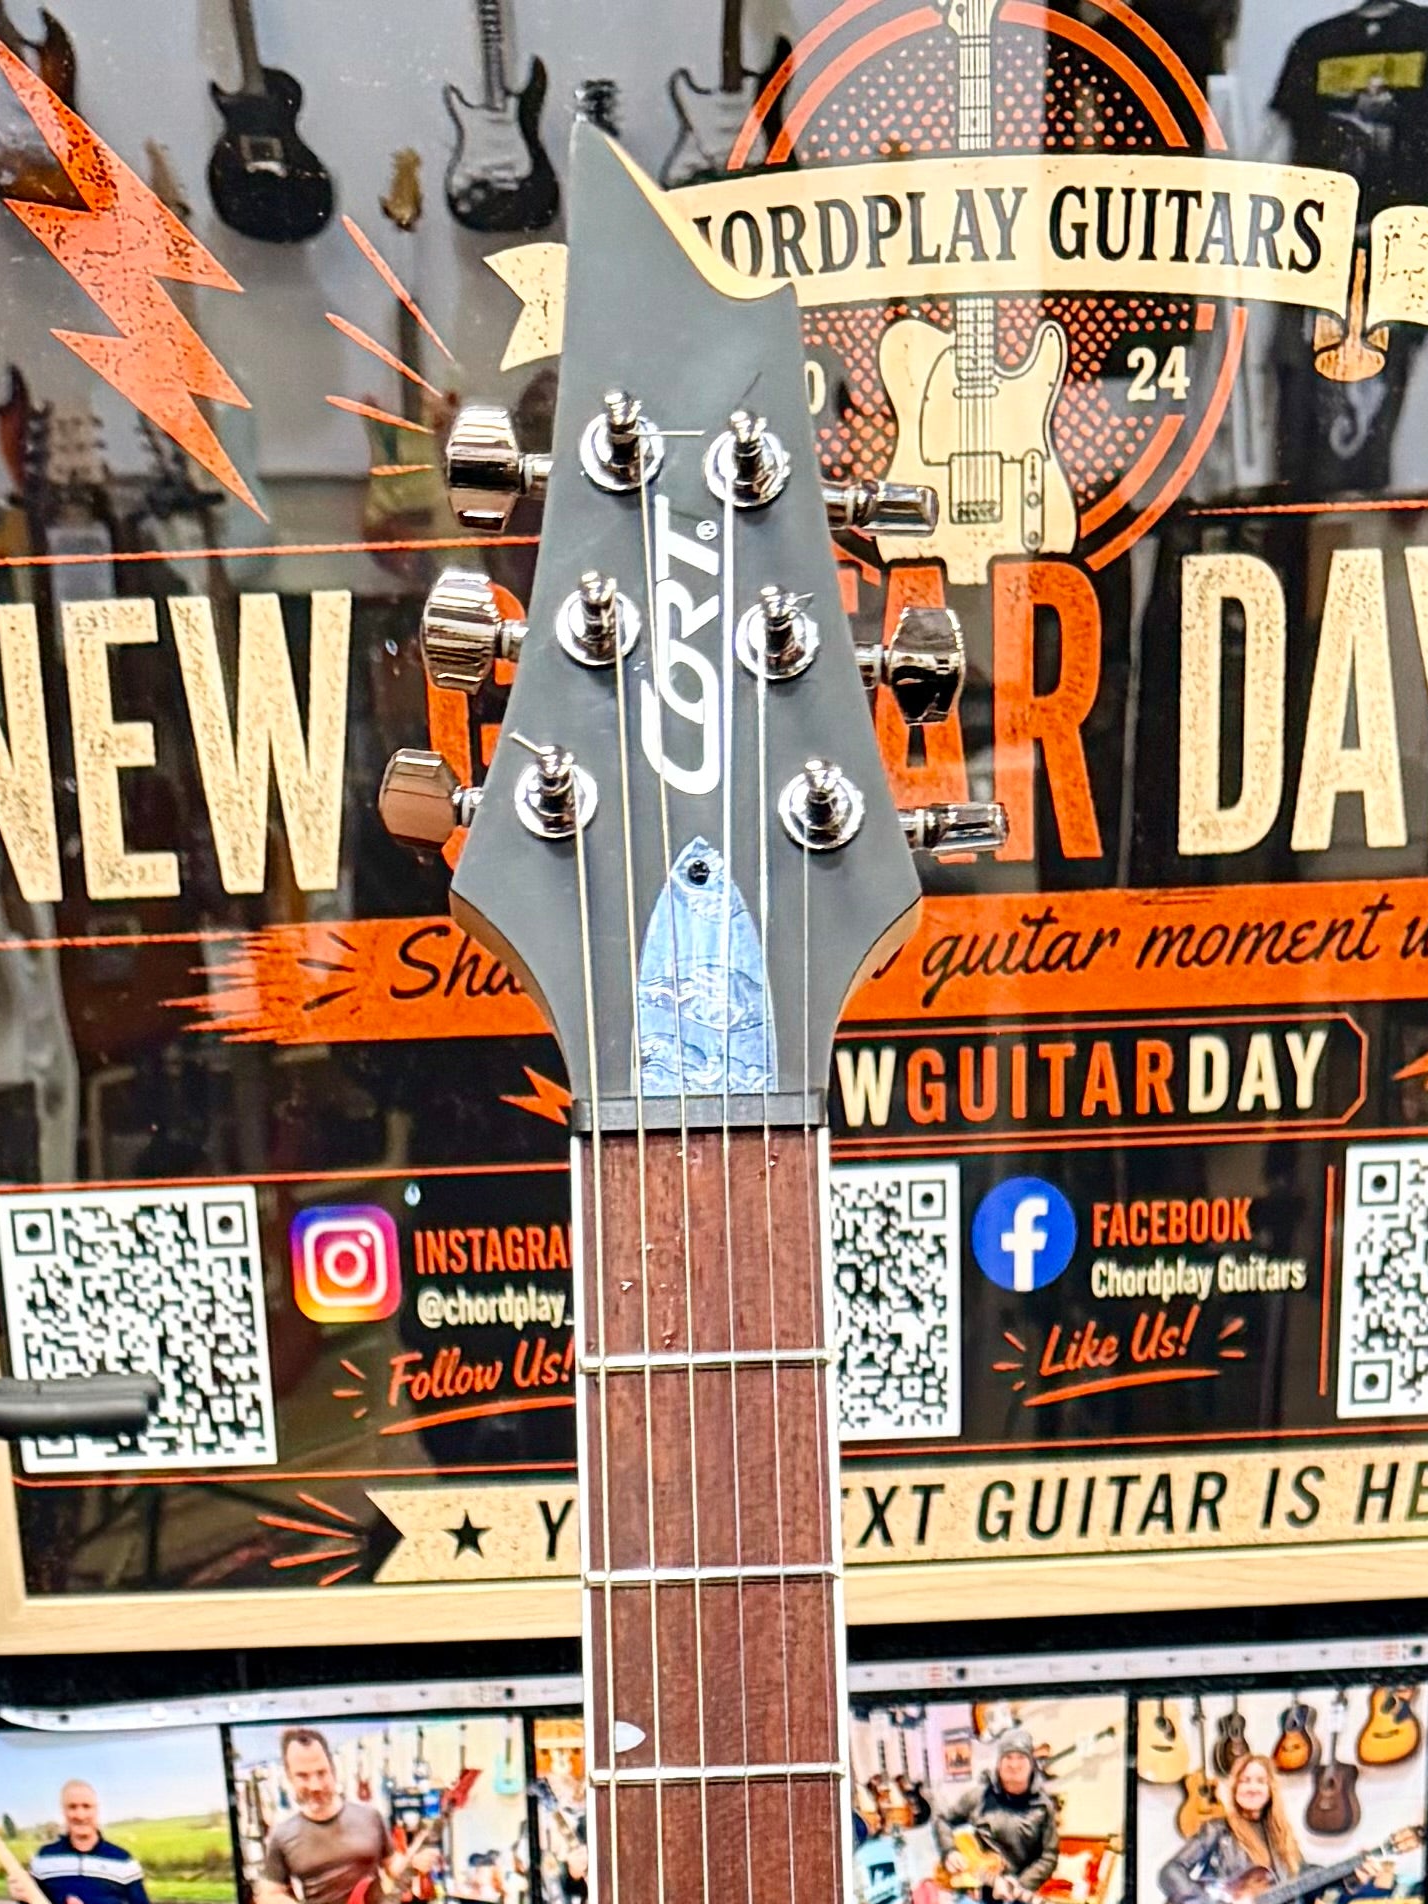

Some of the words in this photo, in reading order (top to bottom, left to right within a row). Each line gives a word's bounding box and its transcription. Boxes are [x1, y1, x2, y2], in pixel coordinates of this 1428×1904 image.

[692, 187, 1027, 279] ORDPLAY
[1050, 185, 1325, 273] GUITARS
[1126, 346, 1189, 401] 24
[922, 905, 1121, 1008] guitar
[1136, 894, 1379, 970] moment
[836, 1031, 1329, 1128] WGUITARDAY
[414, 1224, 572, 1275] INSTAGRA
[1092, 1197, 1253, 1248] FACEBOOK
[417, 1282, 575, 1331] @chordplay_
[1091, 1256, 1214, 1303] Chordplay
[1217, 1255, 1308, 1294] Guitars
[387, 1346, 503, 1407] Follow
[514, 1337, 575, 1387] Us!
[1038, 1318, 1126, 1377] Like
[1130, 1305, 1200, 1359] Us!
[977, 1467, 1230, 1546] GUITAR
[1260, 1464, 1329, 1530] IS
